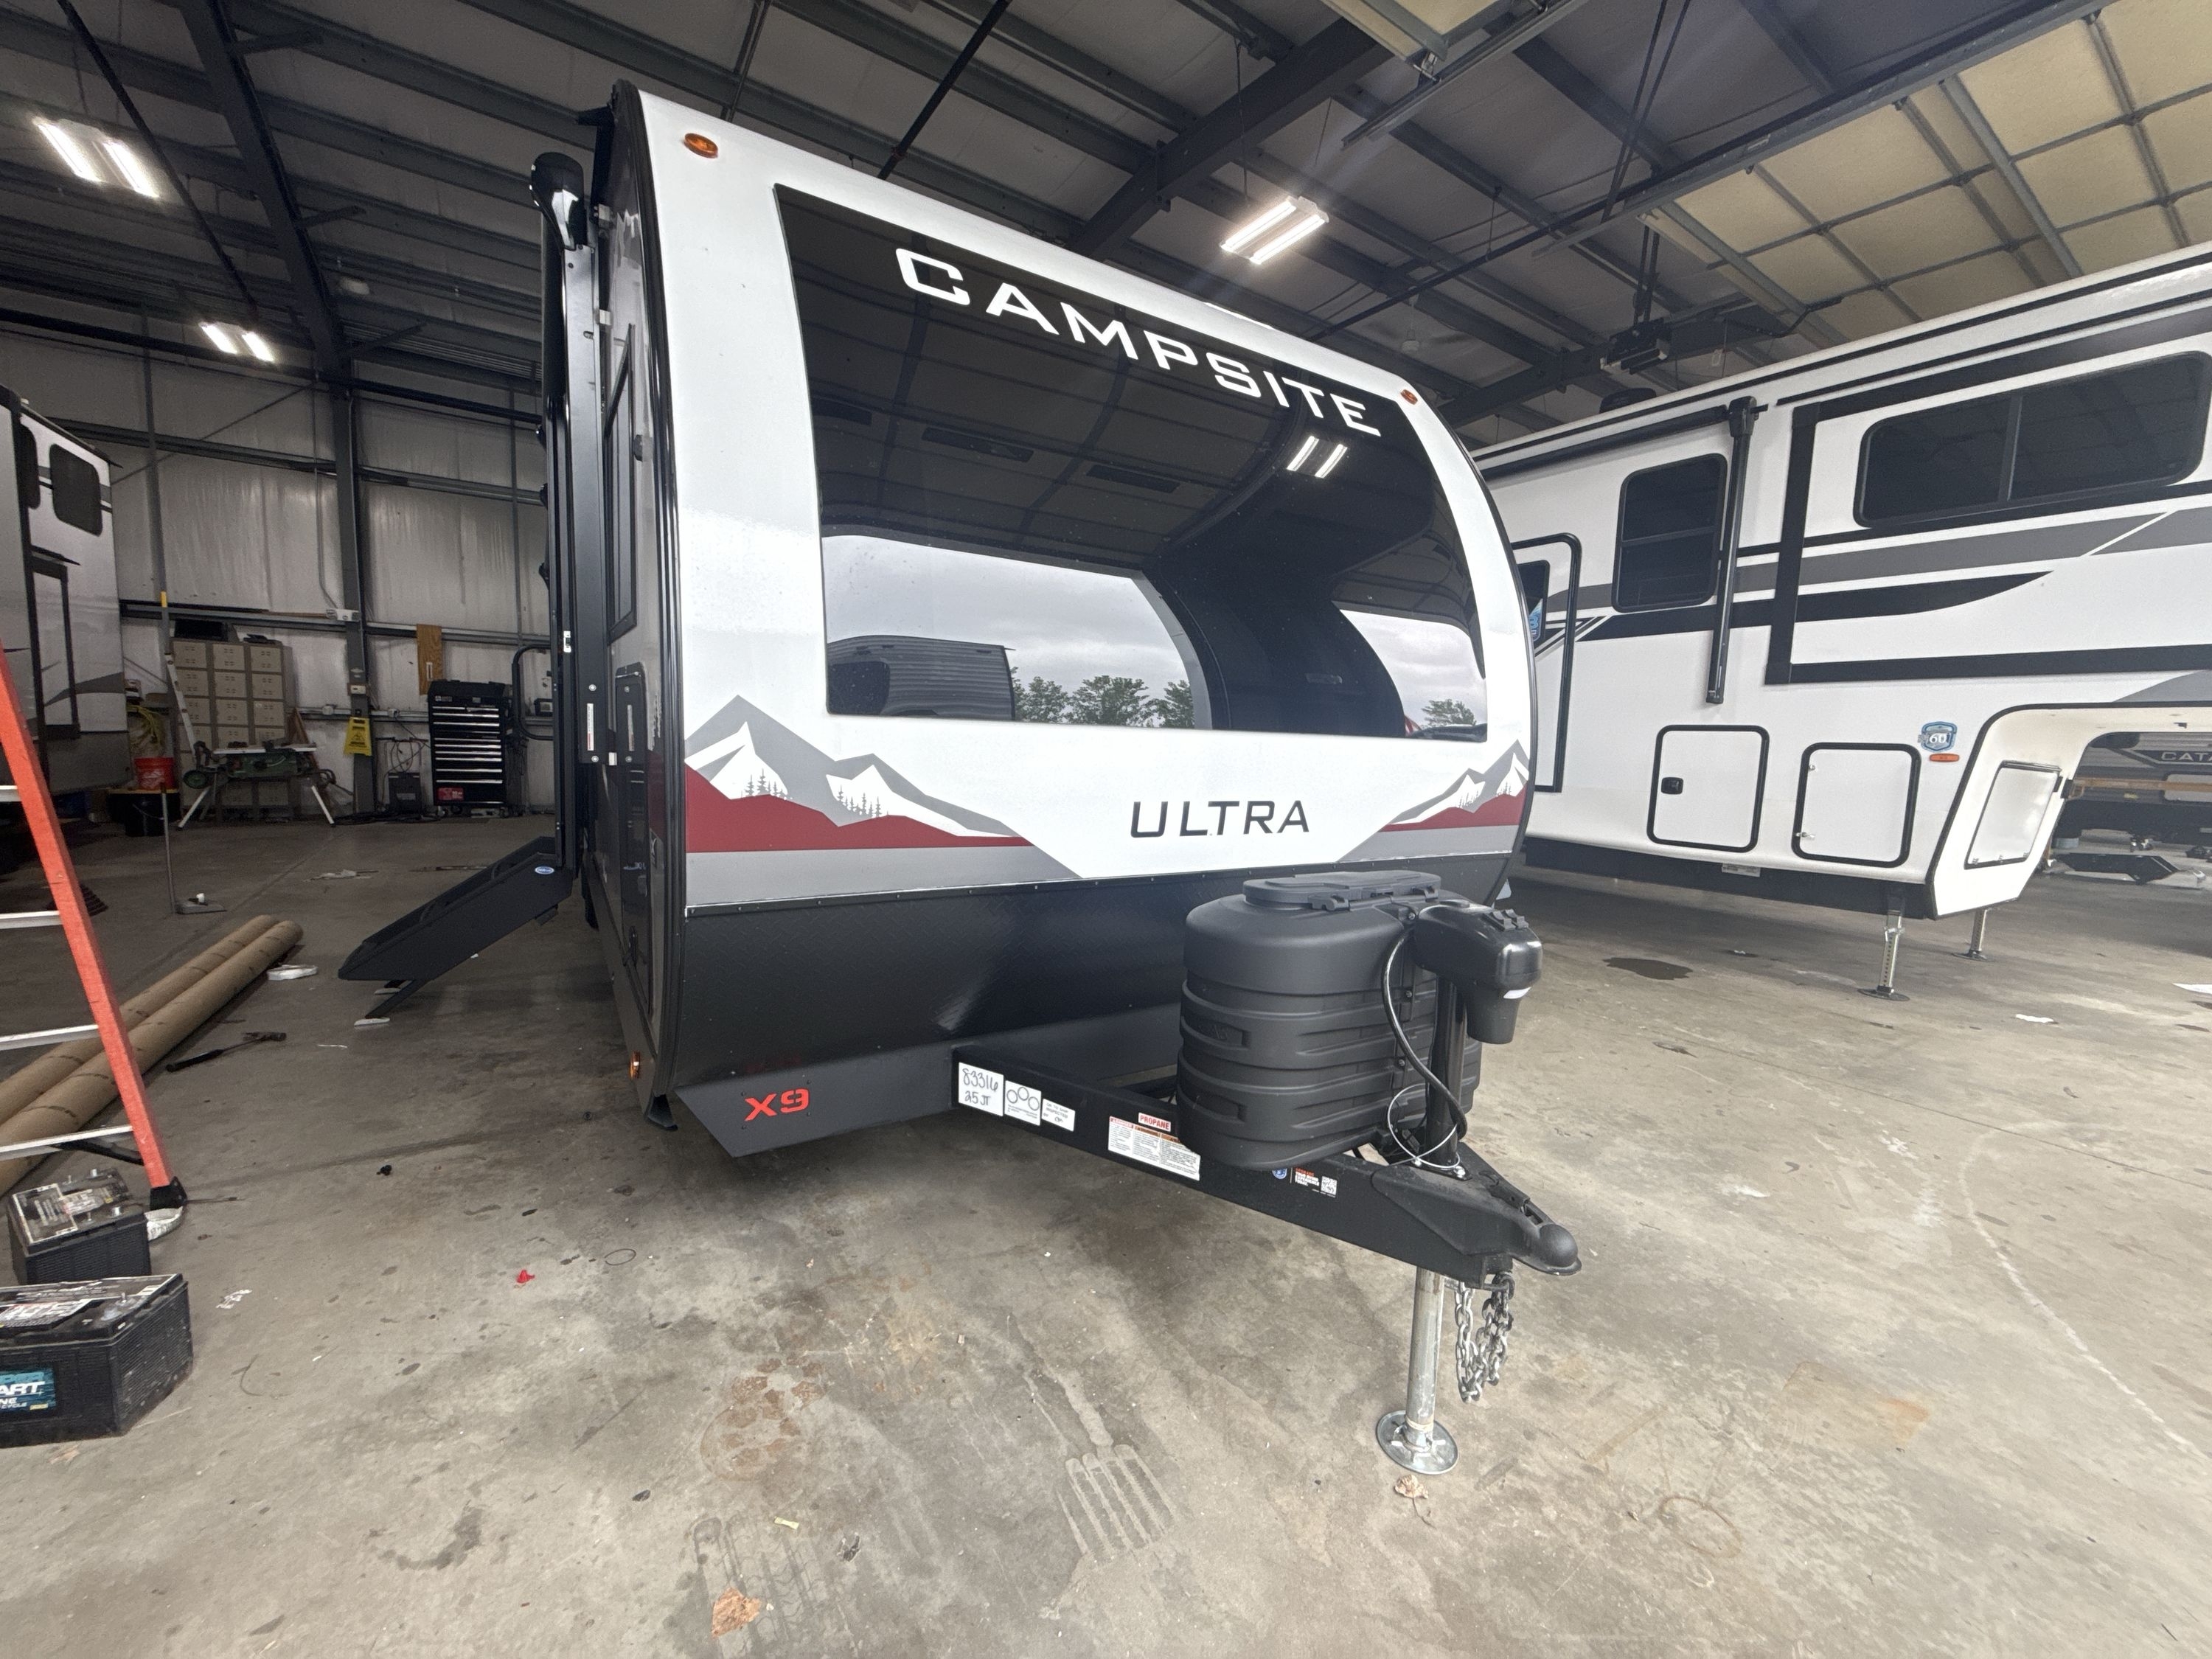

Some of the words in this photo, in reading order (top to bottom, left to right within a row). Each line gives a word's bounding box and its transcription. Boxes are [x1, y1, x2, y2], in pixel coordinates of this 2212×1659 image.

[895, 248, 1381, 437] CAMPSITE
[1130, 800, 1310, 838] ULTRA
[961, 1068, 998, 1092] 83316
[743, 1087, 810, 1121] X9
[1140, 1114, 1170, 1130] PROPANE
